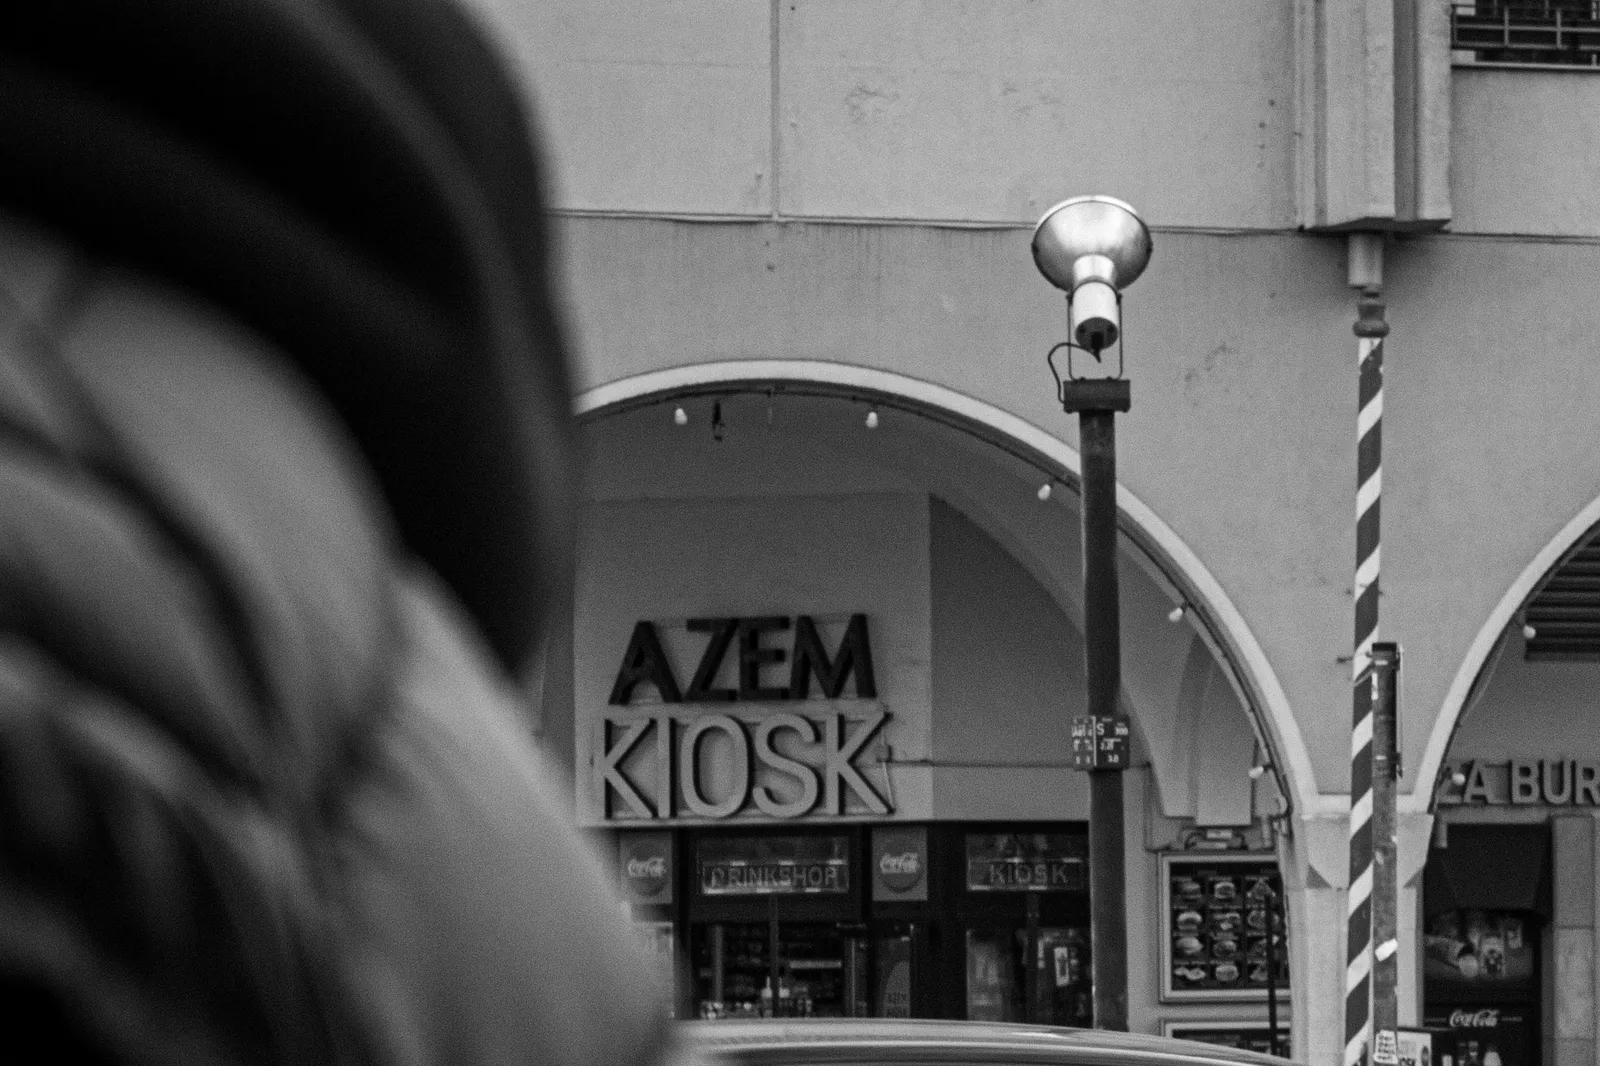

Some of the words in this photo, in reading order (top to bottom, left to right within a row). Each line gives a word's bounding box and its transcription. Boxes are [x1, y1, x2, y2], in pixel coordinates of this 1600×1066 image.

[608, 613, 877, 705] AZEM
[600, 711, 895, 819] KIOSK
[990, 863, 1068, 884] KIOSK
